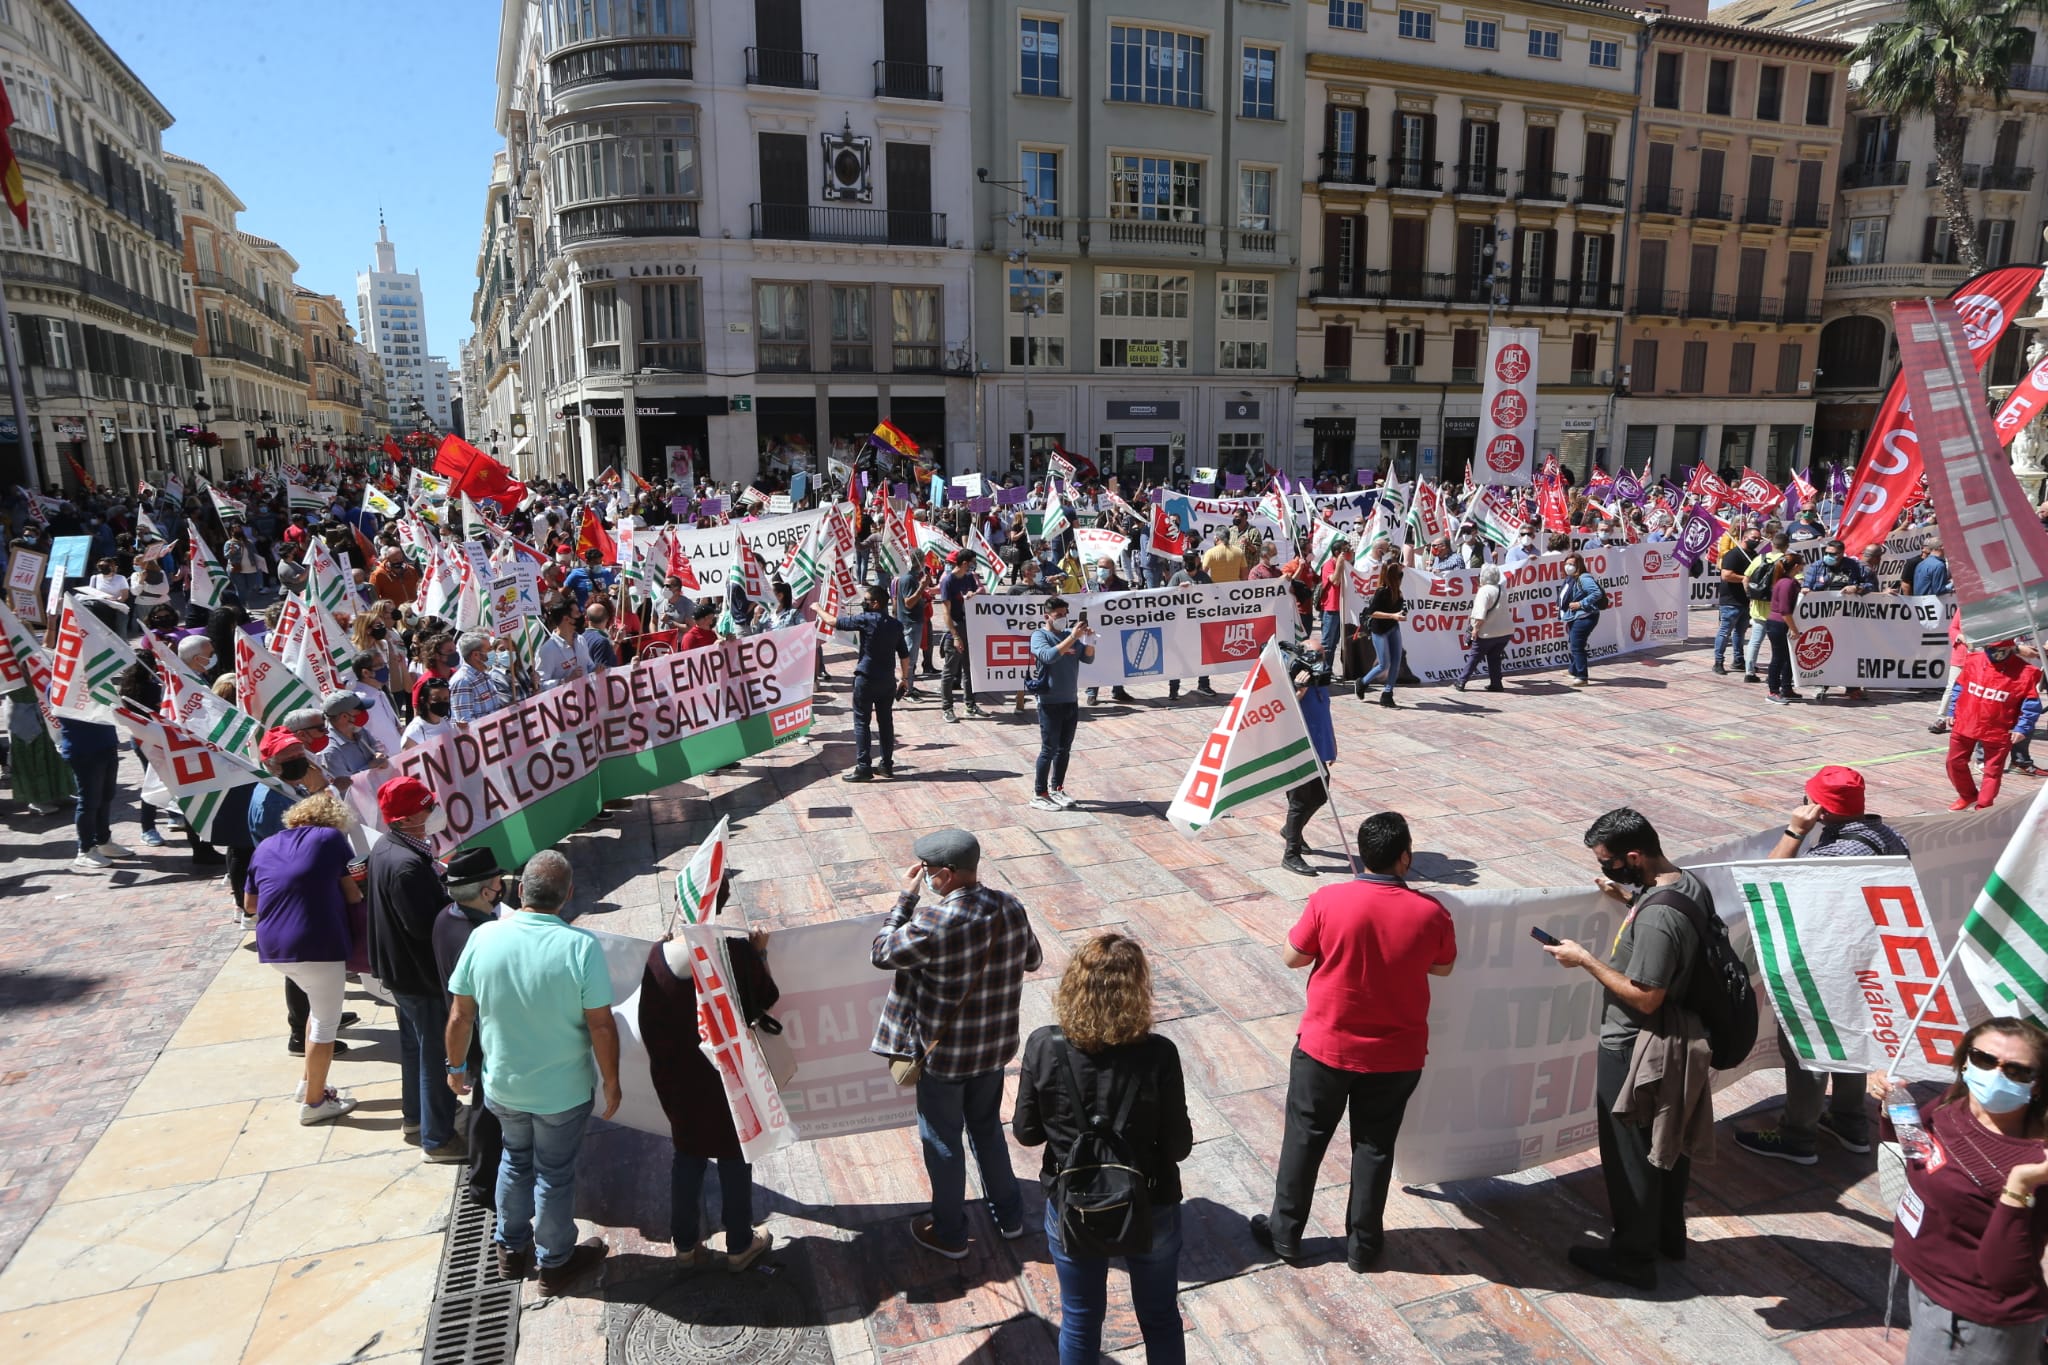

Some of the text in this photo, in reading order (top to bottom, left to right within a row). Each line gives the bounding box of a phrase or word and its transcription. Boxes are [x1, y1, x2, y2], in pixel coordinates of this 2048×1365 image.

[630, 264, 697, 277] LARIOS
[1503, 350, 1524, 363] UGT
[635, 407, 660, 415] SECRET
[1499, 395, 1520, 408] UGT
[1494, 440, 1517, 453] UGT
[1482, 492, 1522, 529] CCOO
[699, 570, 722, 584] NO
[1430, 577, 1464, 597] ES
[976, 602, 1046, 616] MOVIST
[1105, 592, 1203, 611] COTRONIC
[1229, 585, 1287, 601] COBRA
[1418, 600, 1474, 612] DEFENSA
[1507, 587, 1552, 604] ERVICIO
[1101, 609, 1176, 627] Despide
[1187, 604, 1263, 620] Esclaviza
[1654, 611, 1677, 621] STOP
[1800, 600, 1912, 621] CUMPLIMIENTO
[1915, 604, 1938, 621] DE
[1224, 623, 1255, 641] UGT
[1413, 615, 1470, 633] CONT
[1805, 630, 1828, 644] UGT
[992, 641, 1030, 660] CC
[1857, 657, 1946, 680] EMPLEO
[1968, 681, 2010, 703] CCOO
[454, 684, 598, 777] DEFENSA
[607, 666, 668, 711] DEL
[669, 638, 778, 694] EMPLEO
[774, 704, 811, 731] CCOO
[483, 776, 509, 820] A
[508, 742, 575, 803] LOS
[576, 711, 649, 768] ERES
[655, 674, 782, 739] SALVAJES
[1861, 886, 1967, 1066] CCOO
[1855, 970, 1905, 1059] Málaga
